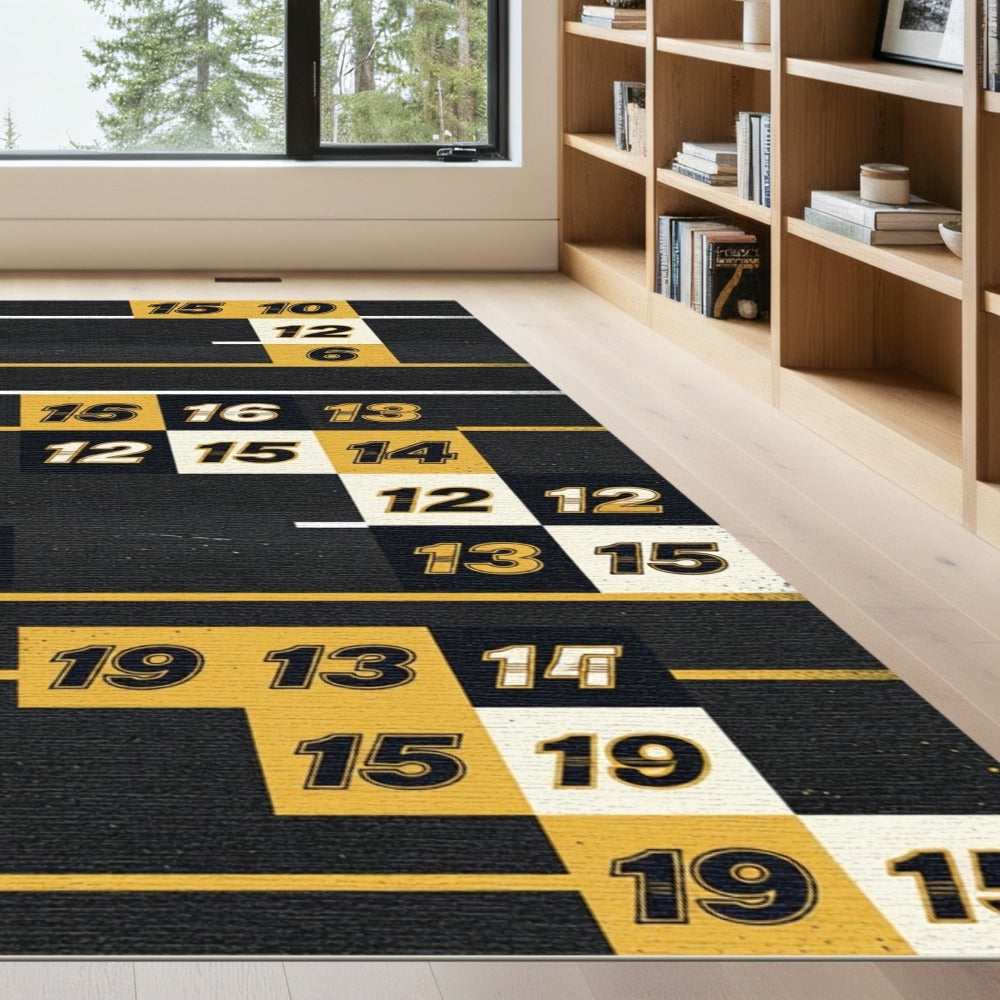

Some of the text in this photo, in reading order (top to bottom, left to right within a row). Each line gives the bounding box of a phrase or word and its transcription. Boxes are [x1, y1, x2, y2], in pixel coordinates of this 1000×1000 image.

[148, 302, 225, 315] 15
[258, 302, 336, 315] 10
[272, 325, 355, 338] 12
[305, 347, 359, 361] 6
[39, 403, 142, 423] 15
[184, 403, 281, 423] 16
[323, 402, 422, 423] 13
[43, 441, 153, 464] 12
[194, 441, 301, 464] 15
[346, 441, 458, 464] 14
[376, 486, 494, 514] 12
[544, 486, 664, 514] 12
[412, 541, 545, 576] 13
[594, 541, 729, 576] 15
[49, 644, 206, 690] 19
[263, 644, 417, 690] 13
[294, 732, 467, 790] 15
[536, 732, 711, 790] 19
[608, 847, 820, 925] 19
